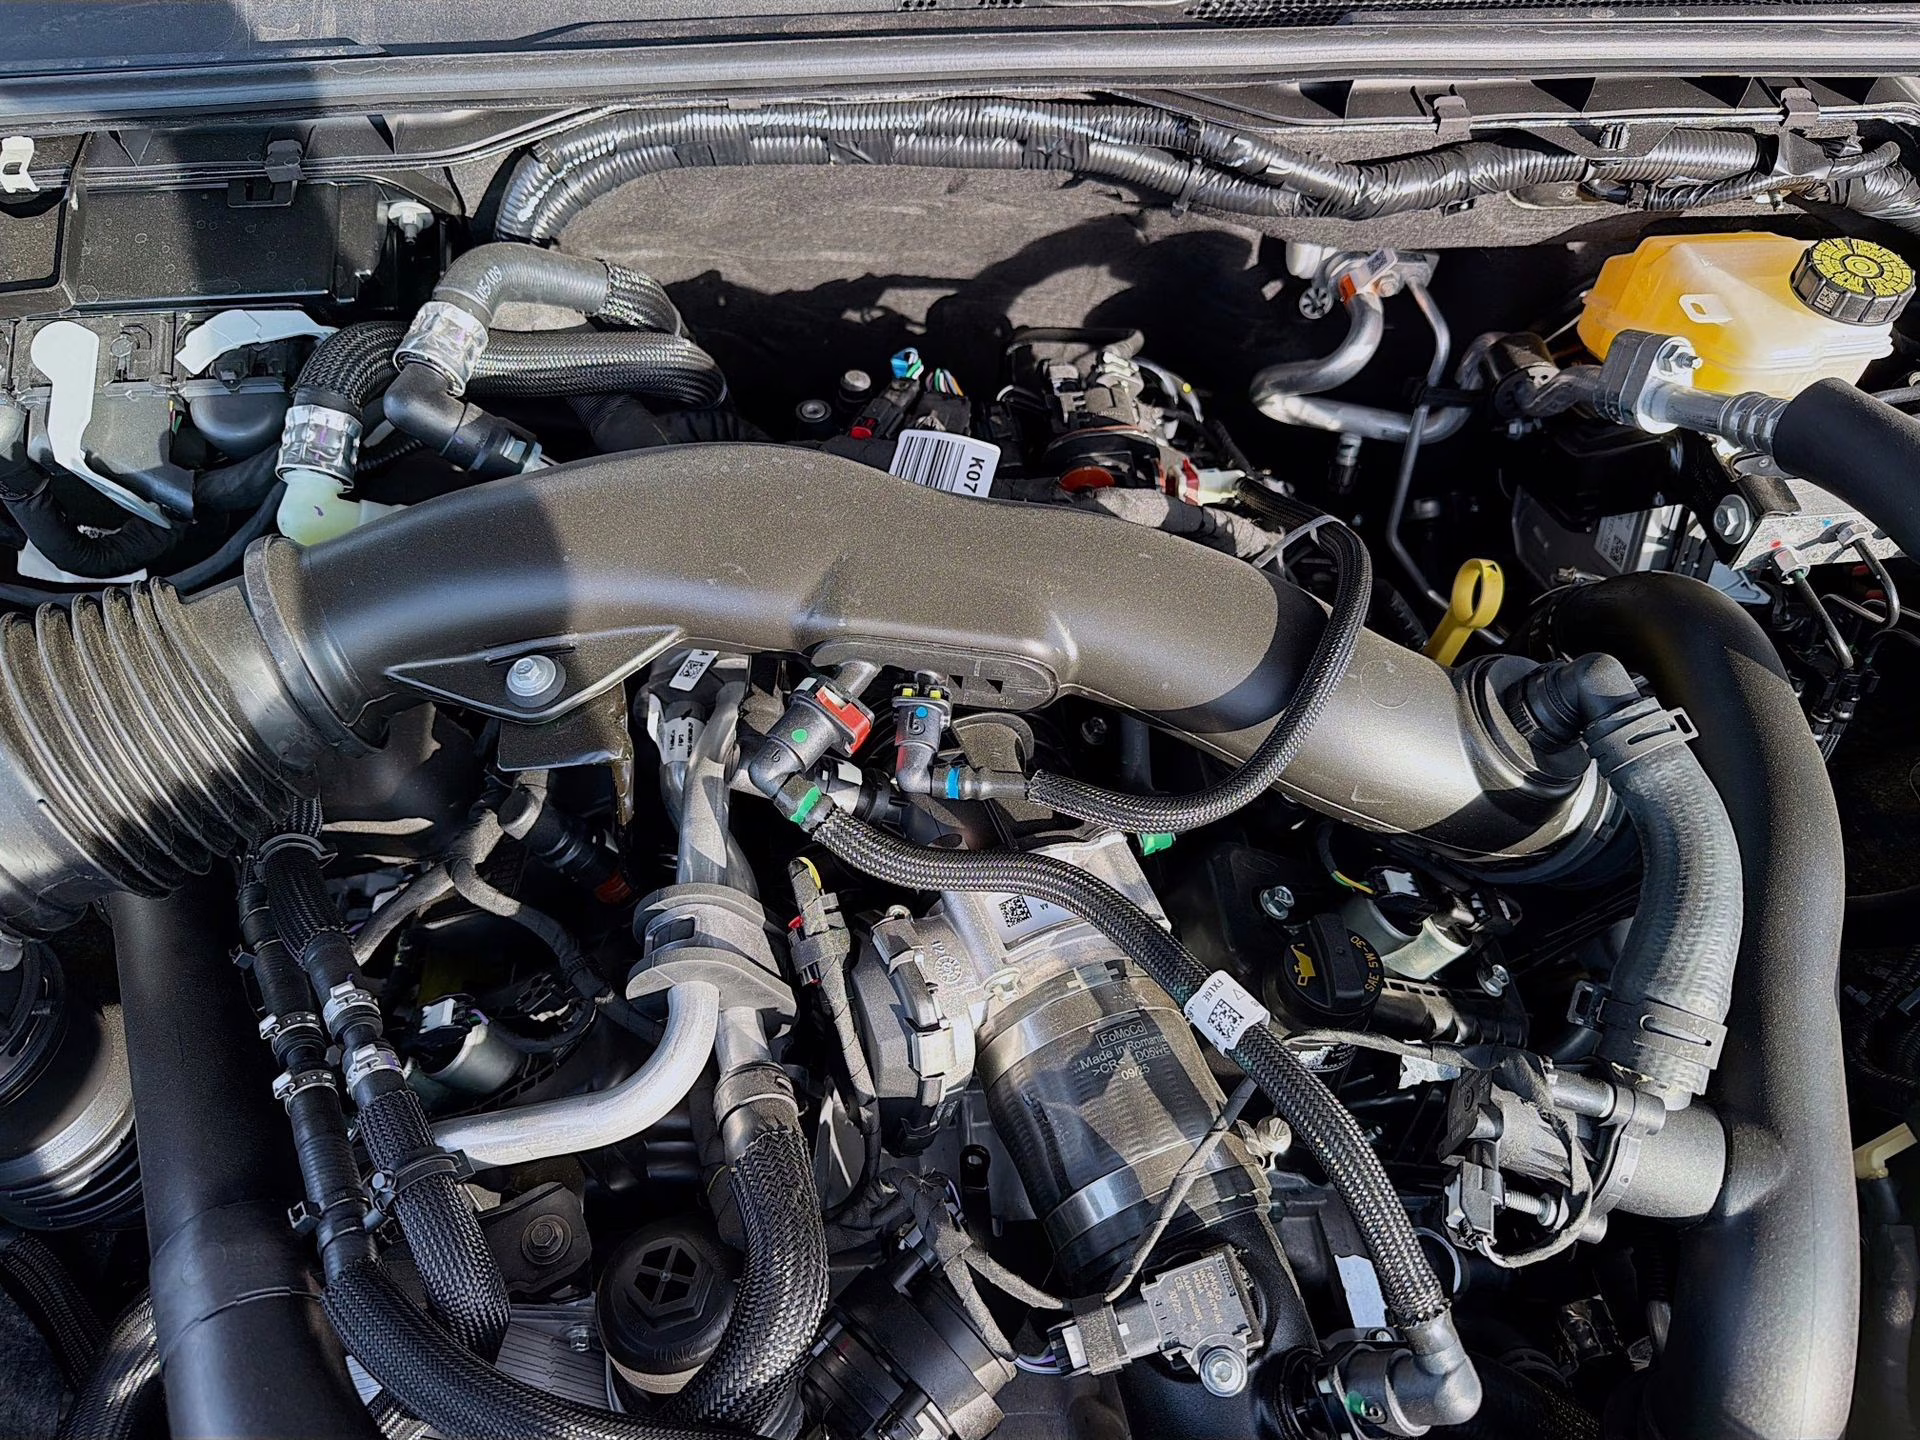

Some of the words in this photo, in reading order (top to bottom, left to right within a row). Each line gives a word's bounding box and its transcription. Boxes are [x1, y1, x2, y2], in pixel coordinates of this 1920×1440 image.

[964, 456, 985, 494] K07
[1350, 935, 1379, 968] 5W-30
[1364, 972, 1379, 992] SAE
[1100, 1024, 1144, 1045] FoMoCo
[1080, 1049, 1113, 1070] Made
[1114, 1045, 1125, 1056] in
[1126, 1033, 1167, 1051] Romania
[1121, 1063, 1150, 1081] 09/25
[1205, 1265, 1222, 1301] FoMoCo
